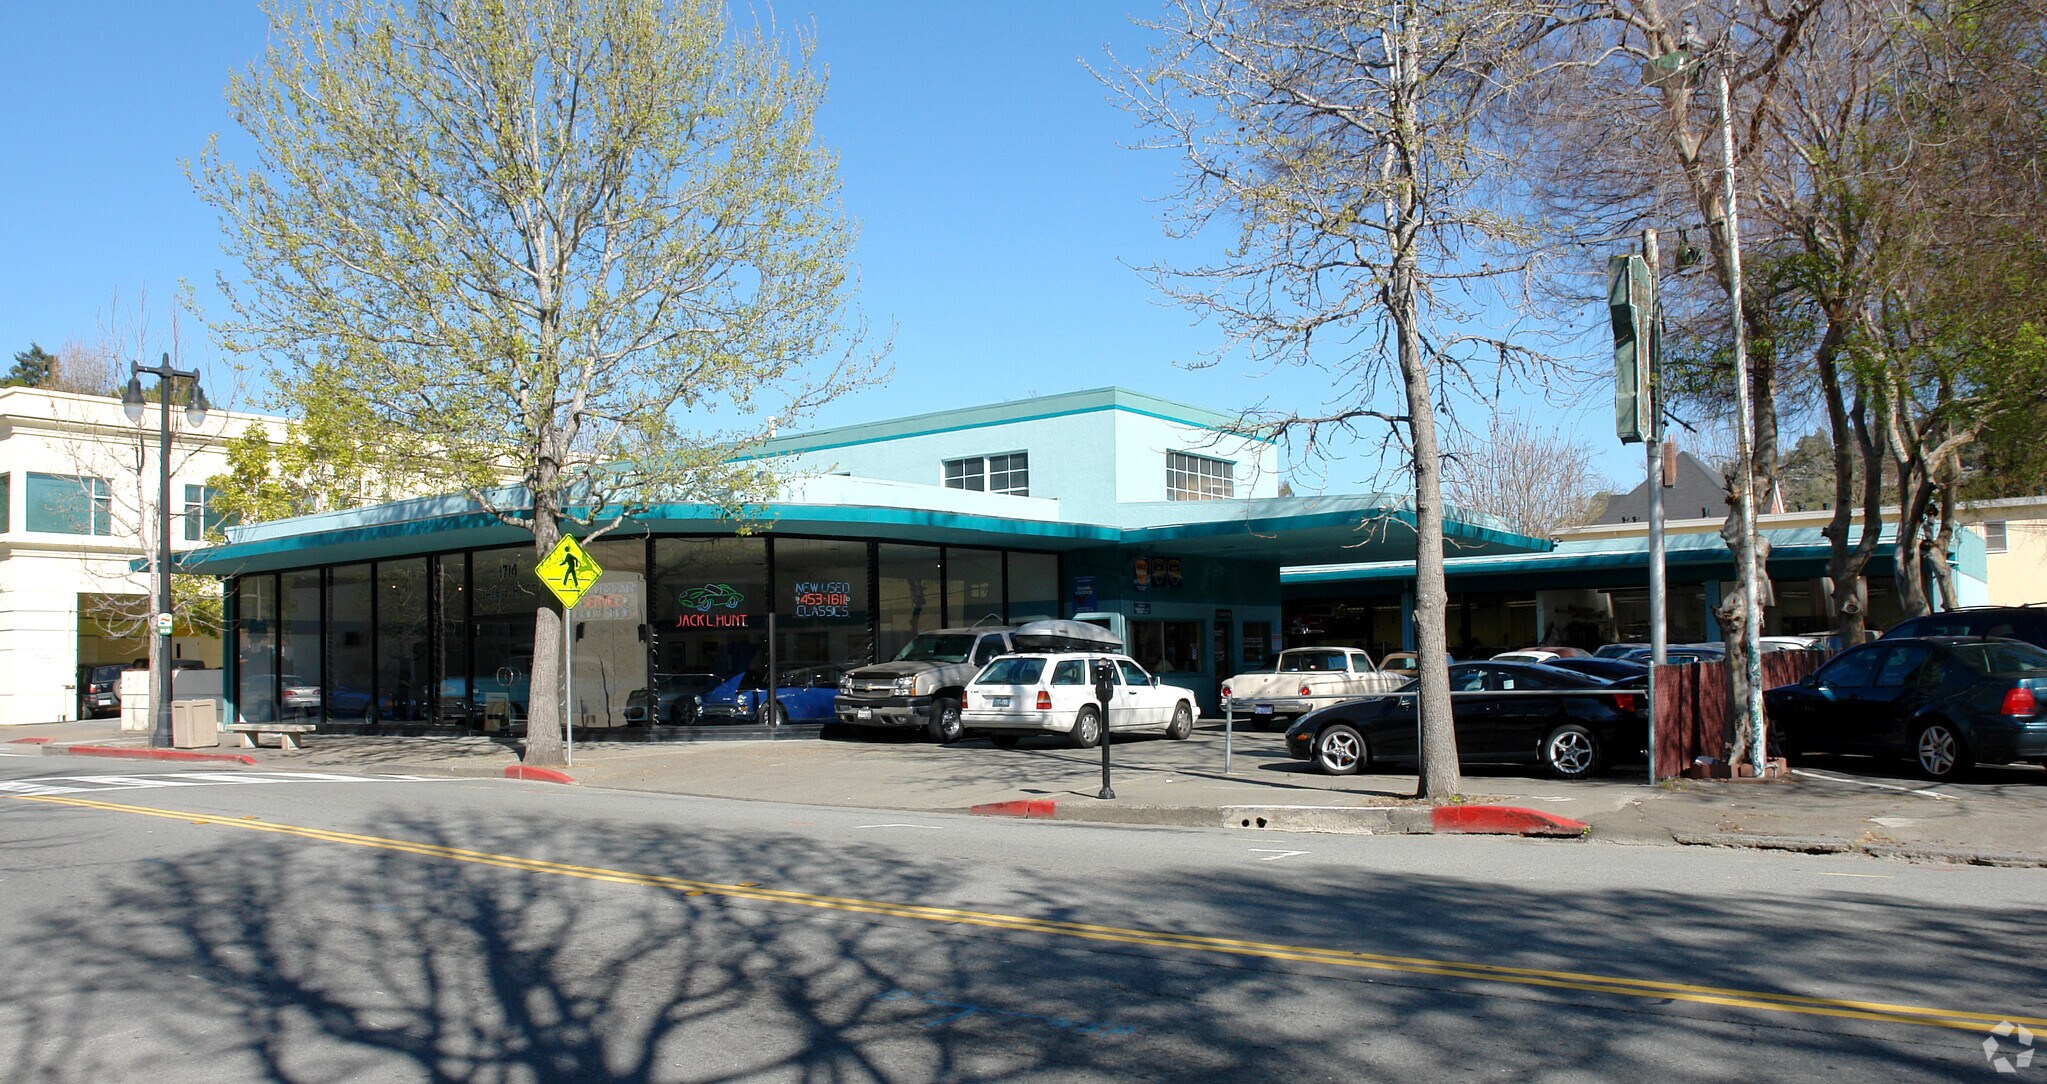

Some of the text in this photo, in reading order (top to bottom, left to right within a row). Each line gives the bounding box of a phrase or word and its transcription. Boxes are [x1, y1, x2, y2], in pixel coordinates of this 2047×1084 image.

[795, 582, 850, 593] NEW USED
[800, 593, 847, 605] 453-1611
[796, 605, 849, 617] CLASSICS
[676, 614, 704, 627] JACK
[716, 614, 748, 627] HUNT
